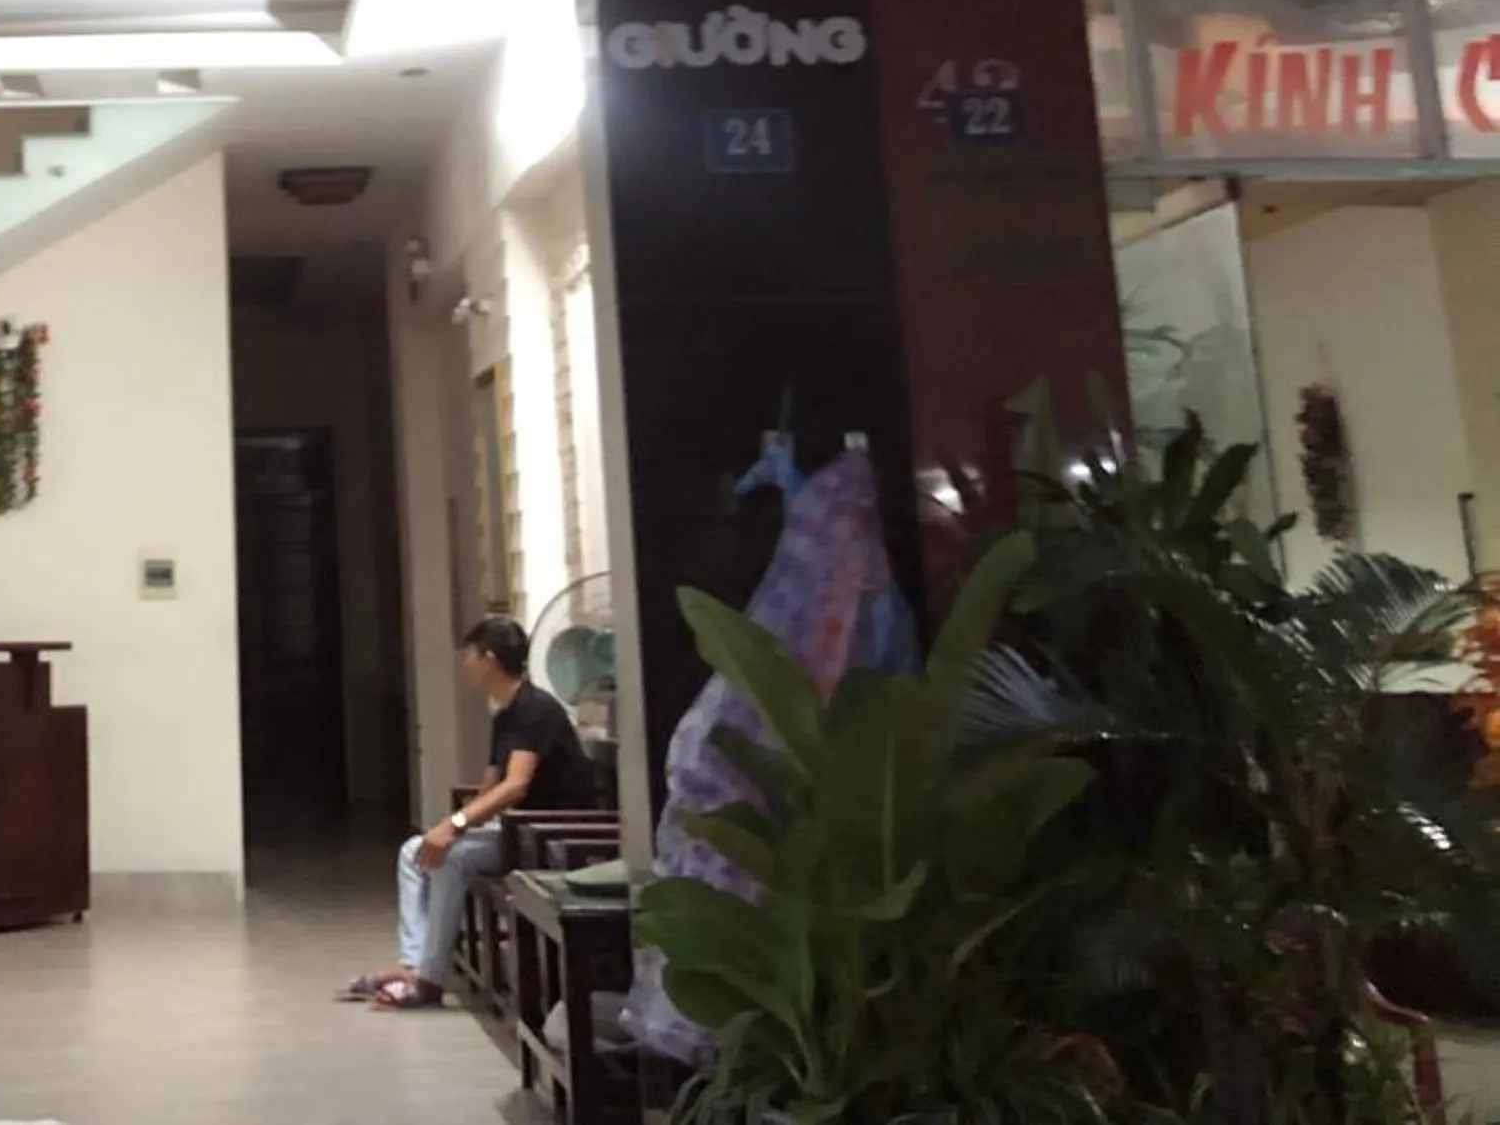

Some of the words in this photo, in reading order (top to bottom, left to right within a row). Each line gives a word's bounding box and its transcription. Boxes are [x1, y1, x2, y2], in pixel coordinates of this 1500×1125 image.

[606, 5, 867, 68] GIƯỜNG
[1173, 32, 1394, 136] KÍNH
[725, 118, 772, 155] 24
[961, 96, 1012, 135] 22
